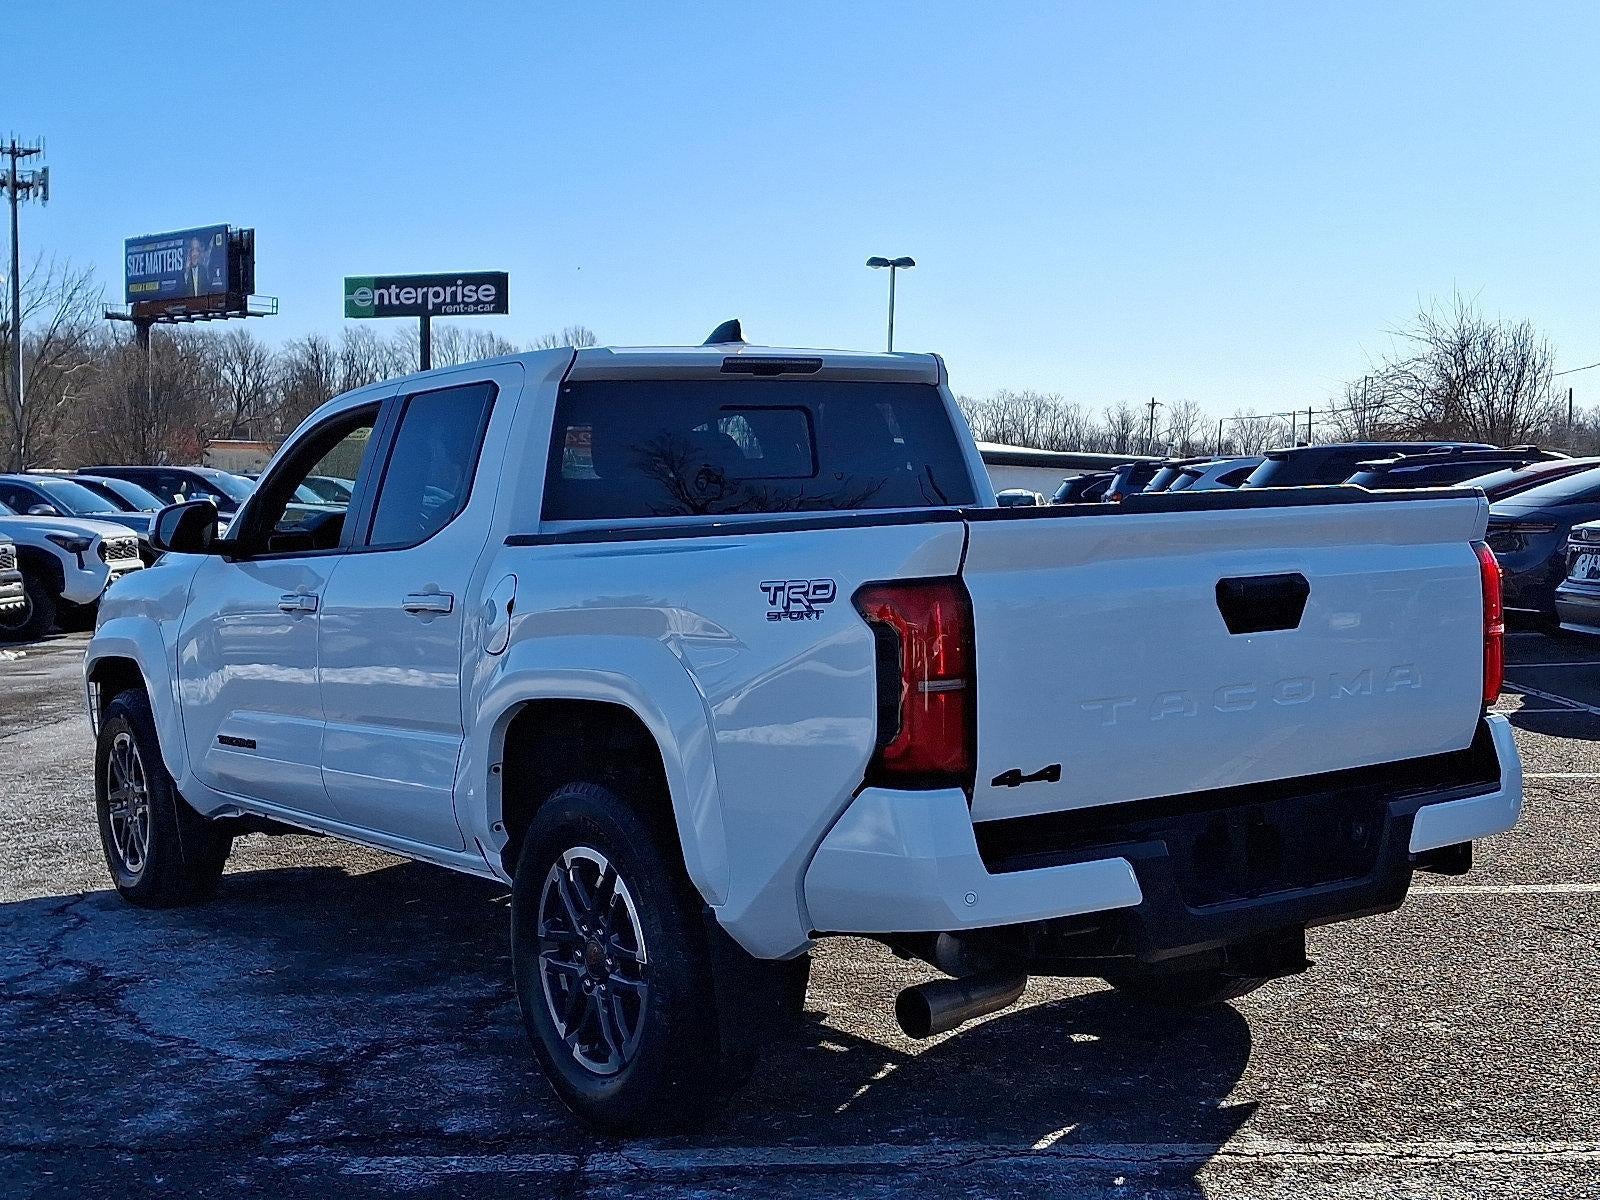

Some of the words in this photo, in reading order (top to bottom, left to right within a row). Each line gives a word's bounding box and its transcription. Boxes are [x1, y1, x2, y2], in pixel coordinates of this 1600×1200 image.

[127, 253, 144, 277] SIZE
[145, 248, 183, 275] MATTERS
[350, 279, 496, 310] enterprise
[441, 303, 495, 314] rent-a-car
[760, 579, 837, 611] TRD
[766, 610, 824, 622] SPORT
[1081, 663, 1422, 726] TACOMA
